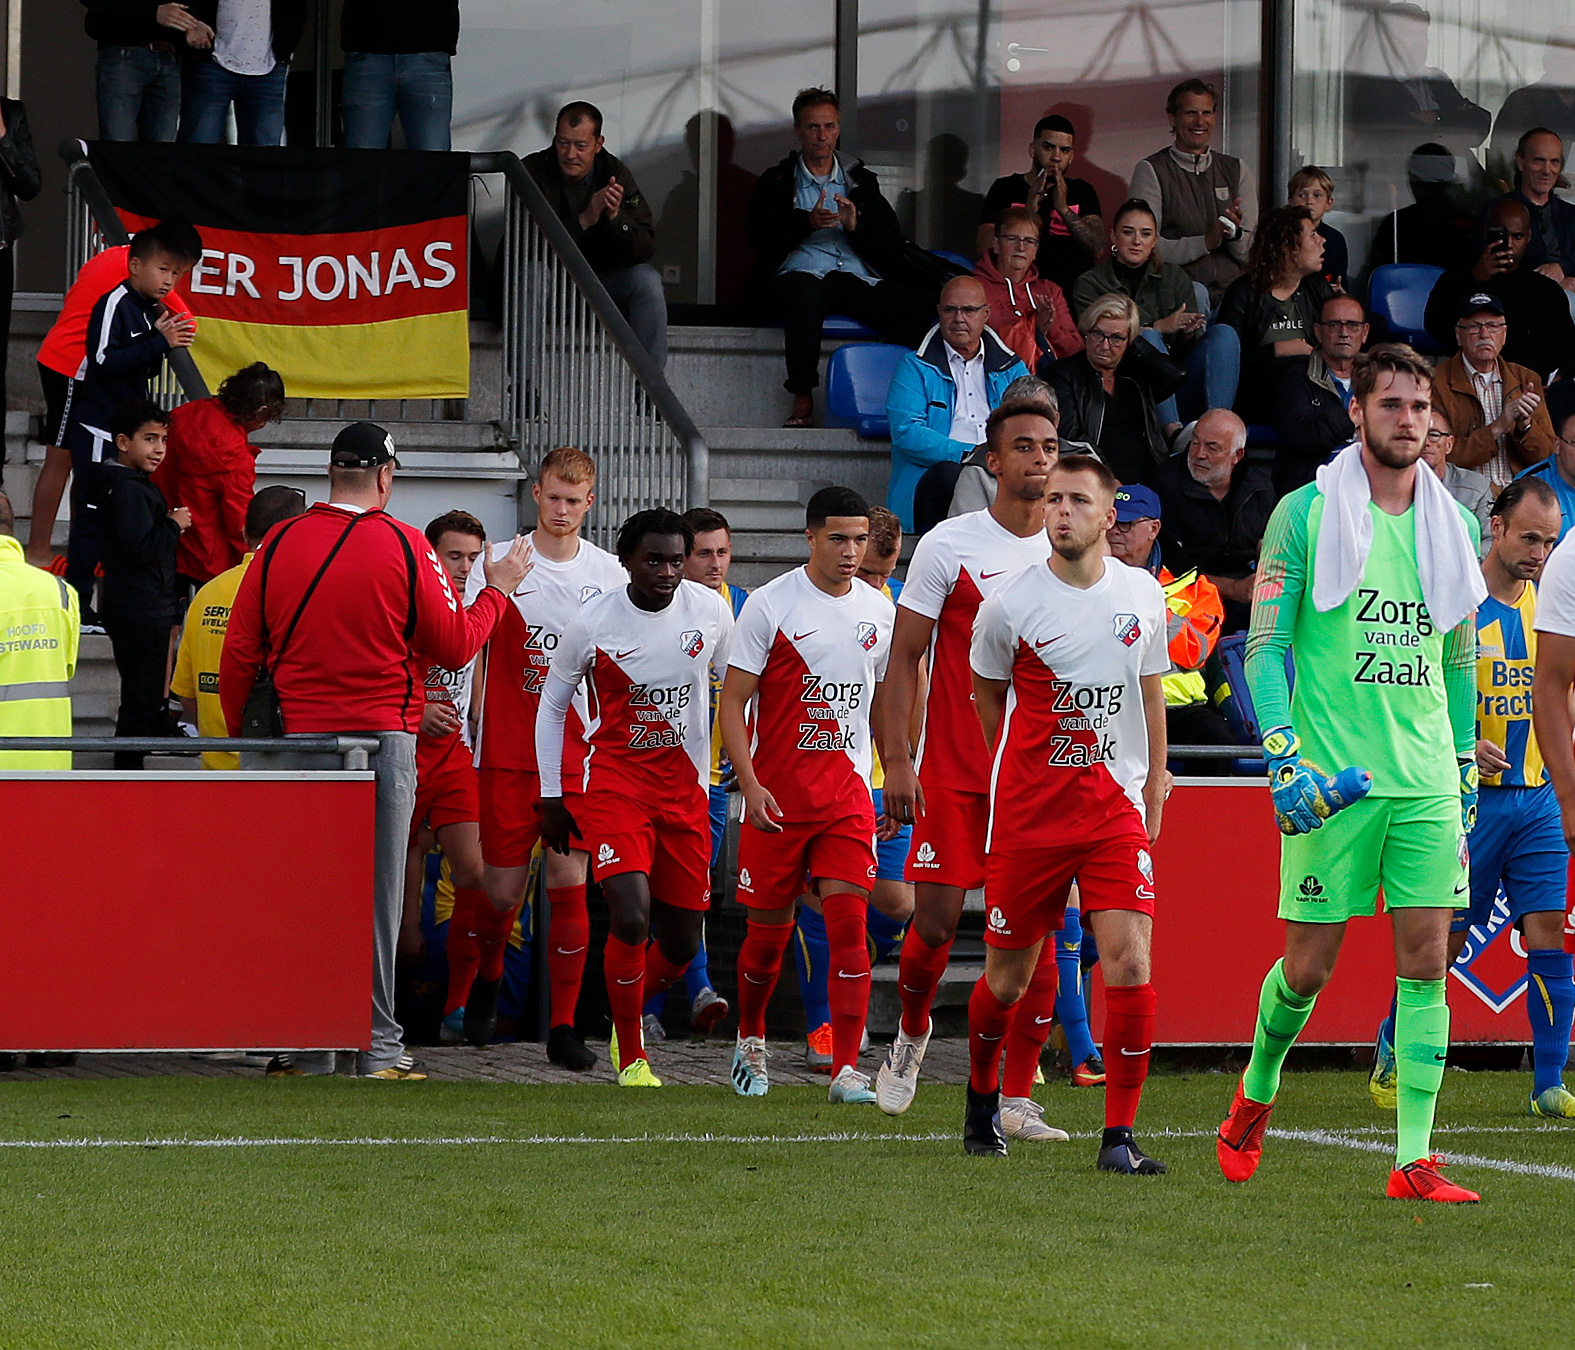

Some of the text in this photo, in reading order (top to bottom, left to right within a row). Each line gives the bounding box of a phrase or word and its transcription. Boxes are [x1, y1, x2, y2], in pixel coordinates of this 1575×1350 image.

[278, 242, 456, 301] JONAS
[1356, 588, 1433, 636] Zorg
[0, 638, 59, 653] STEWARD
[1364, 630, 1420, 647] van de
[1354, 652, 1431, 687] Zaak
[1492, 661, 1534, 687] Bes
[629, 683, 693, 709] Zorg
[801, 674, 864, 710] Zorg
[1052, 681, 1125, 716] Zorg
[636, 707, 681, 721] van de
[807, 706, 850, 719] van de
[1059, 713, 1109, 730] van de
[628, 722, 688, 748] Zaak
[797, 723, 856, 751] Zaak
[1049, 733, 1116, 766] Zaak
